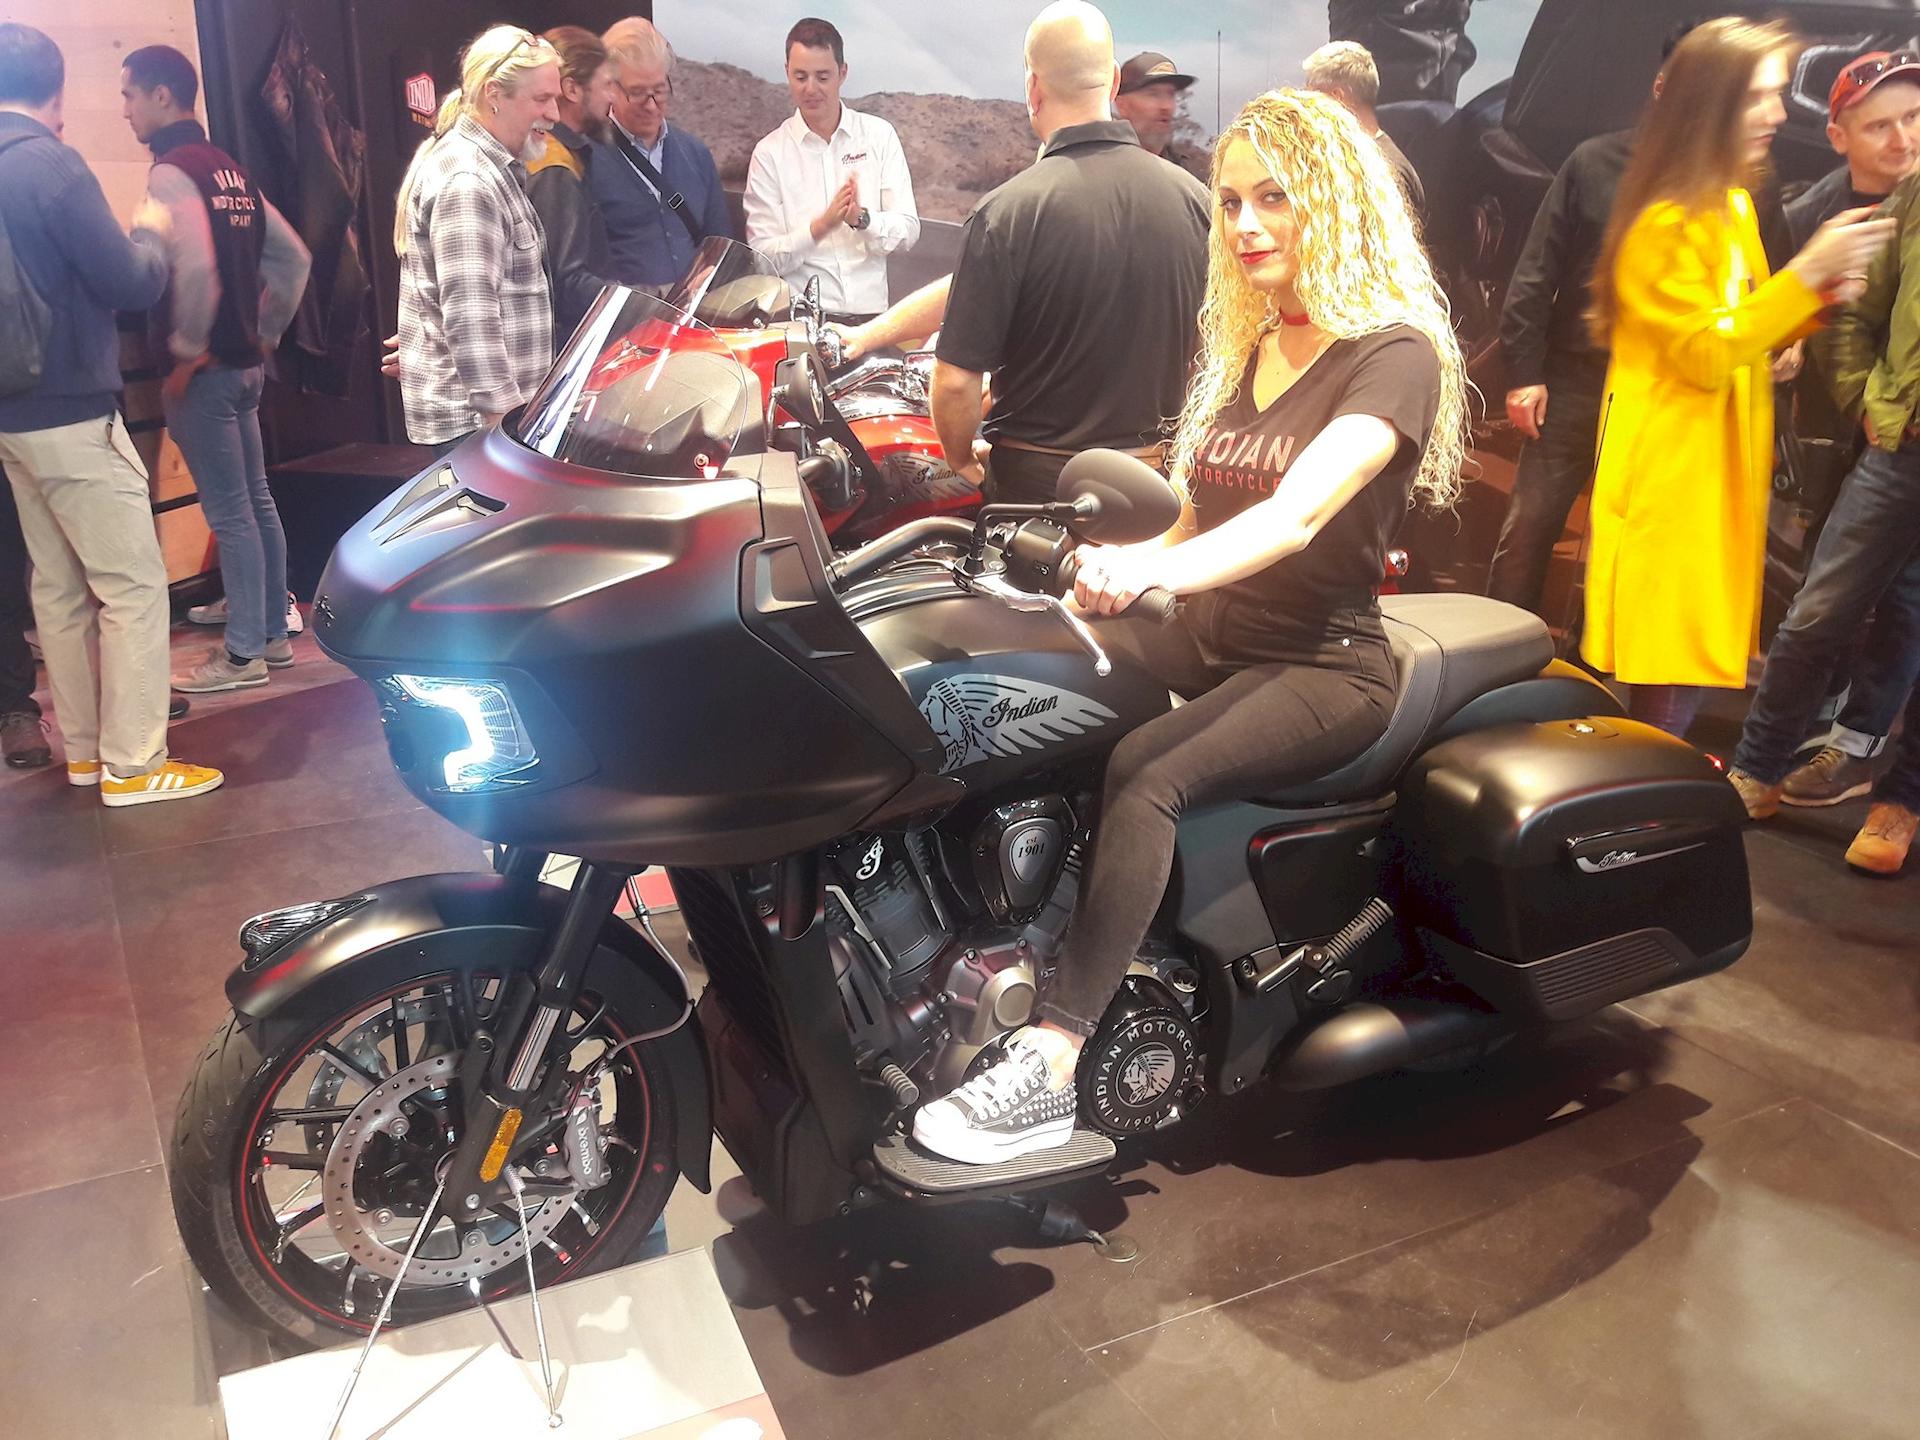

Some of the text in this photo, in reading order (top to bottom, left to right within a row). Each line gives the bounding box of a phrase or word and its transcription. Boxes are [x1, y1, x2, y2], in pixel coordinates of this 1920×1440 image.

[982, 695, 1058, 728] Indian
[1017, 842, 1045, 858] 1901
[1096, 1021, 1194, 1117] INDIAN MOTORCYCLE
[1124, 1111, 1161, 1131] 1901
[577, 1126, 593, 1175] brembo
